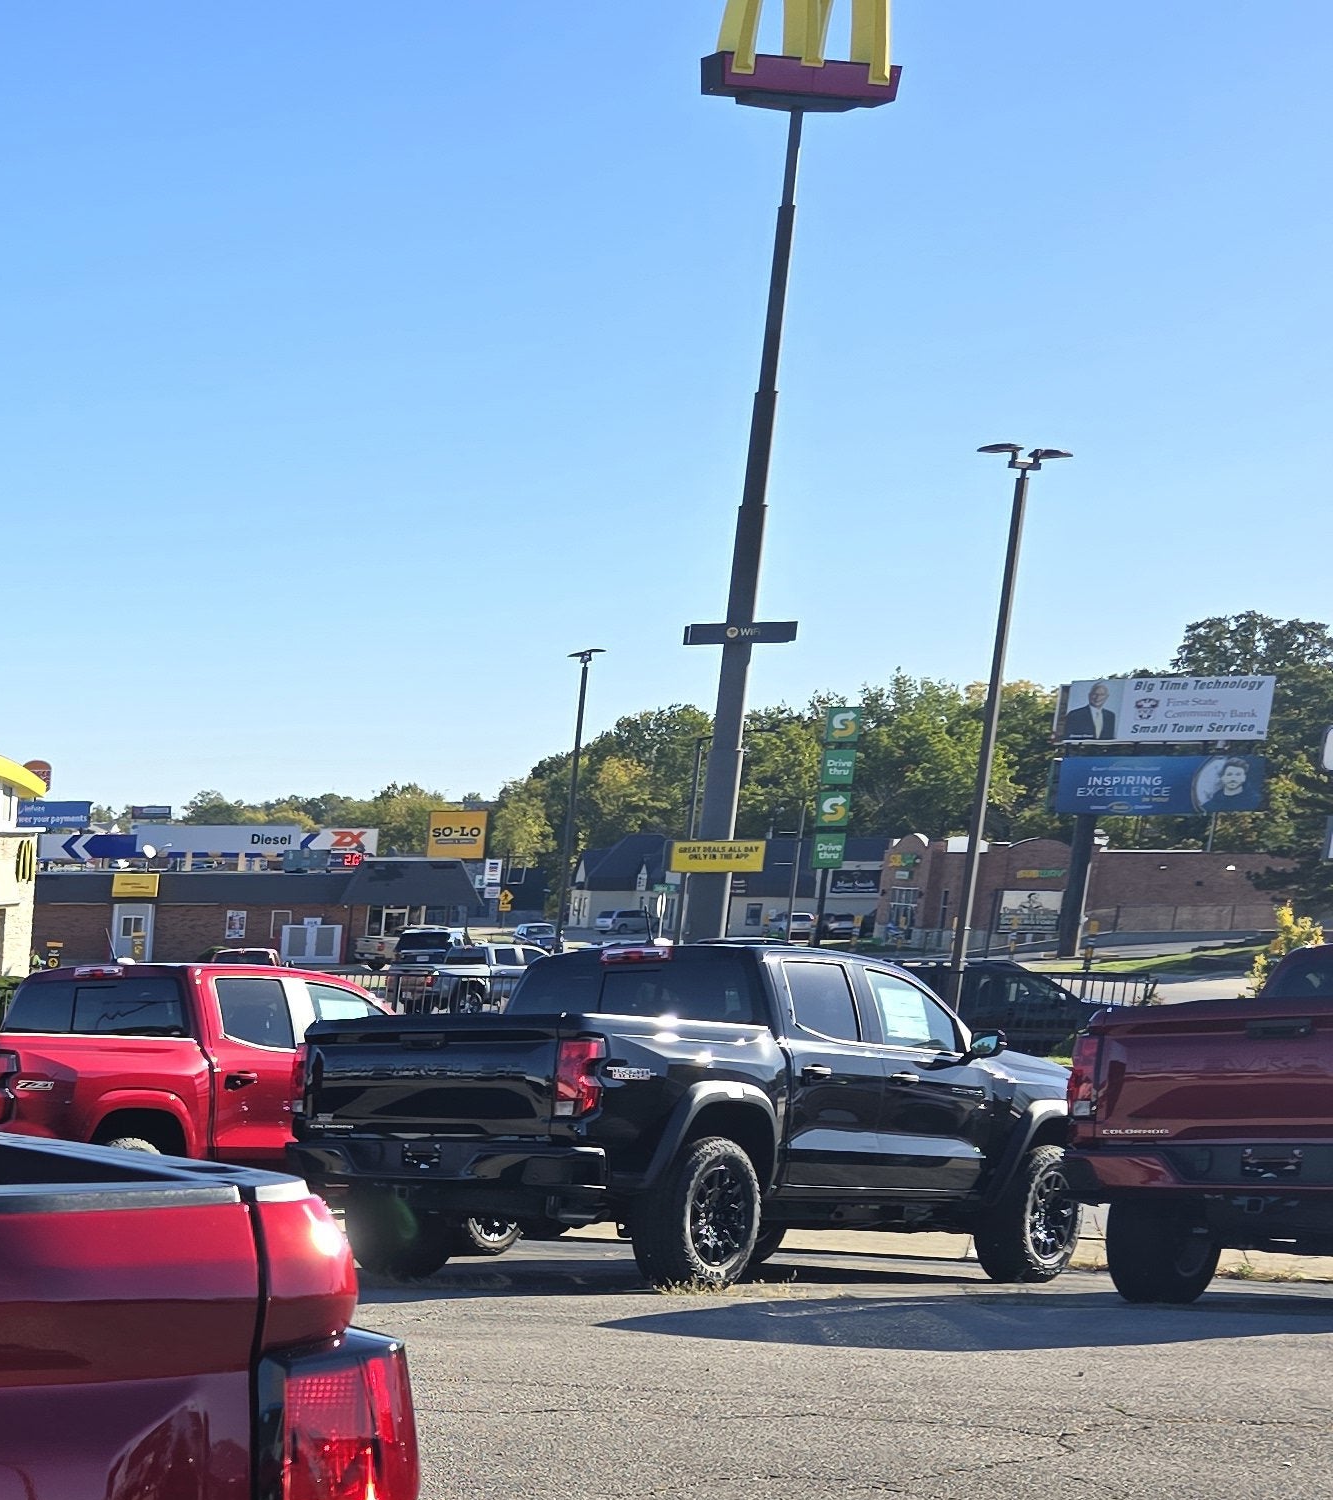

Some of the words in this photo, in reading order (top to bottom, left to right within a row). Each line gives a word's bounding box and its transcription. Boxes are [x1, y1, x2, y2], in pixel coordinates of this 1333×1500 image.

[1134, 681, 1155, 692] Big
[1159, 680, 1188, 691] Time
[1193, 679, 1265, 691] Technology
[1164, 709, 1227, 720] Community
[1230, 709, 1257, 718] Bank
[1131, 723, 1168, 734] Small
[1172, 723, 1203, 733] Town
[1207, 722, 1255, 733] Service
[827, 759, 852, 767] Drive
[829, 767, 849, 775] thru
[1088, 776, 1162, 786] INSPIRING
[1077, 786, 1171, 797] EXCELLENCE
[33, 816, 50, 824] your
[432, 826, 481, 837] SO-LO
[251, 833, 292, 845] Diesel
[817, 843, 842, 852] Drive
[735, 852, 749, 860] APP
[818, 851, 840, 859] thru
